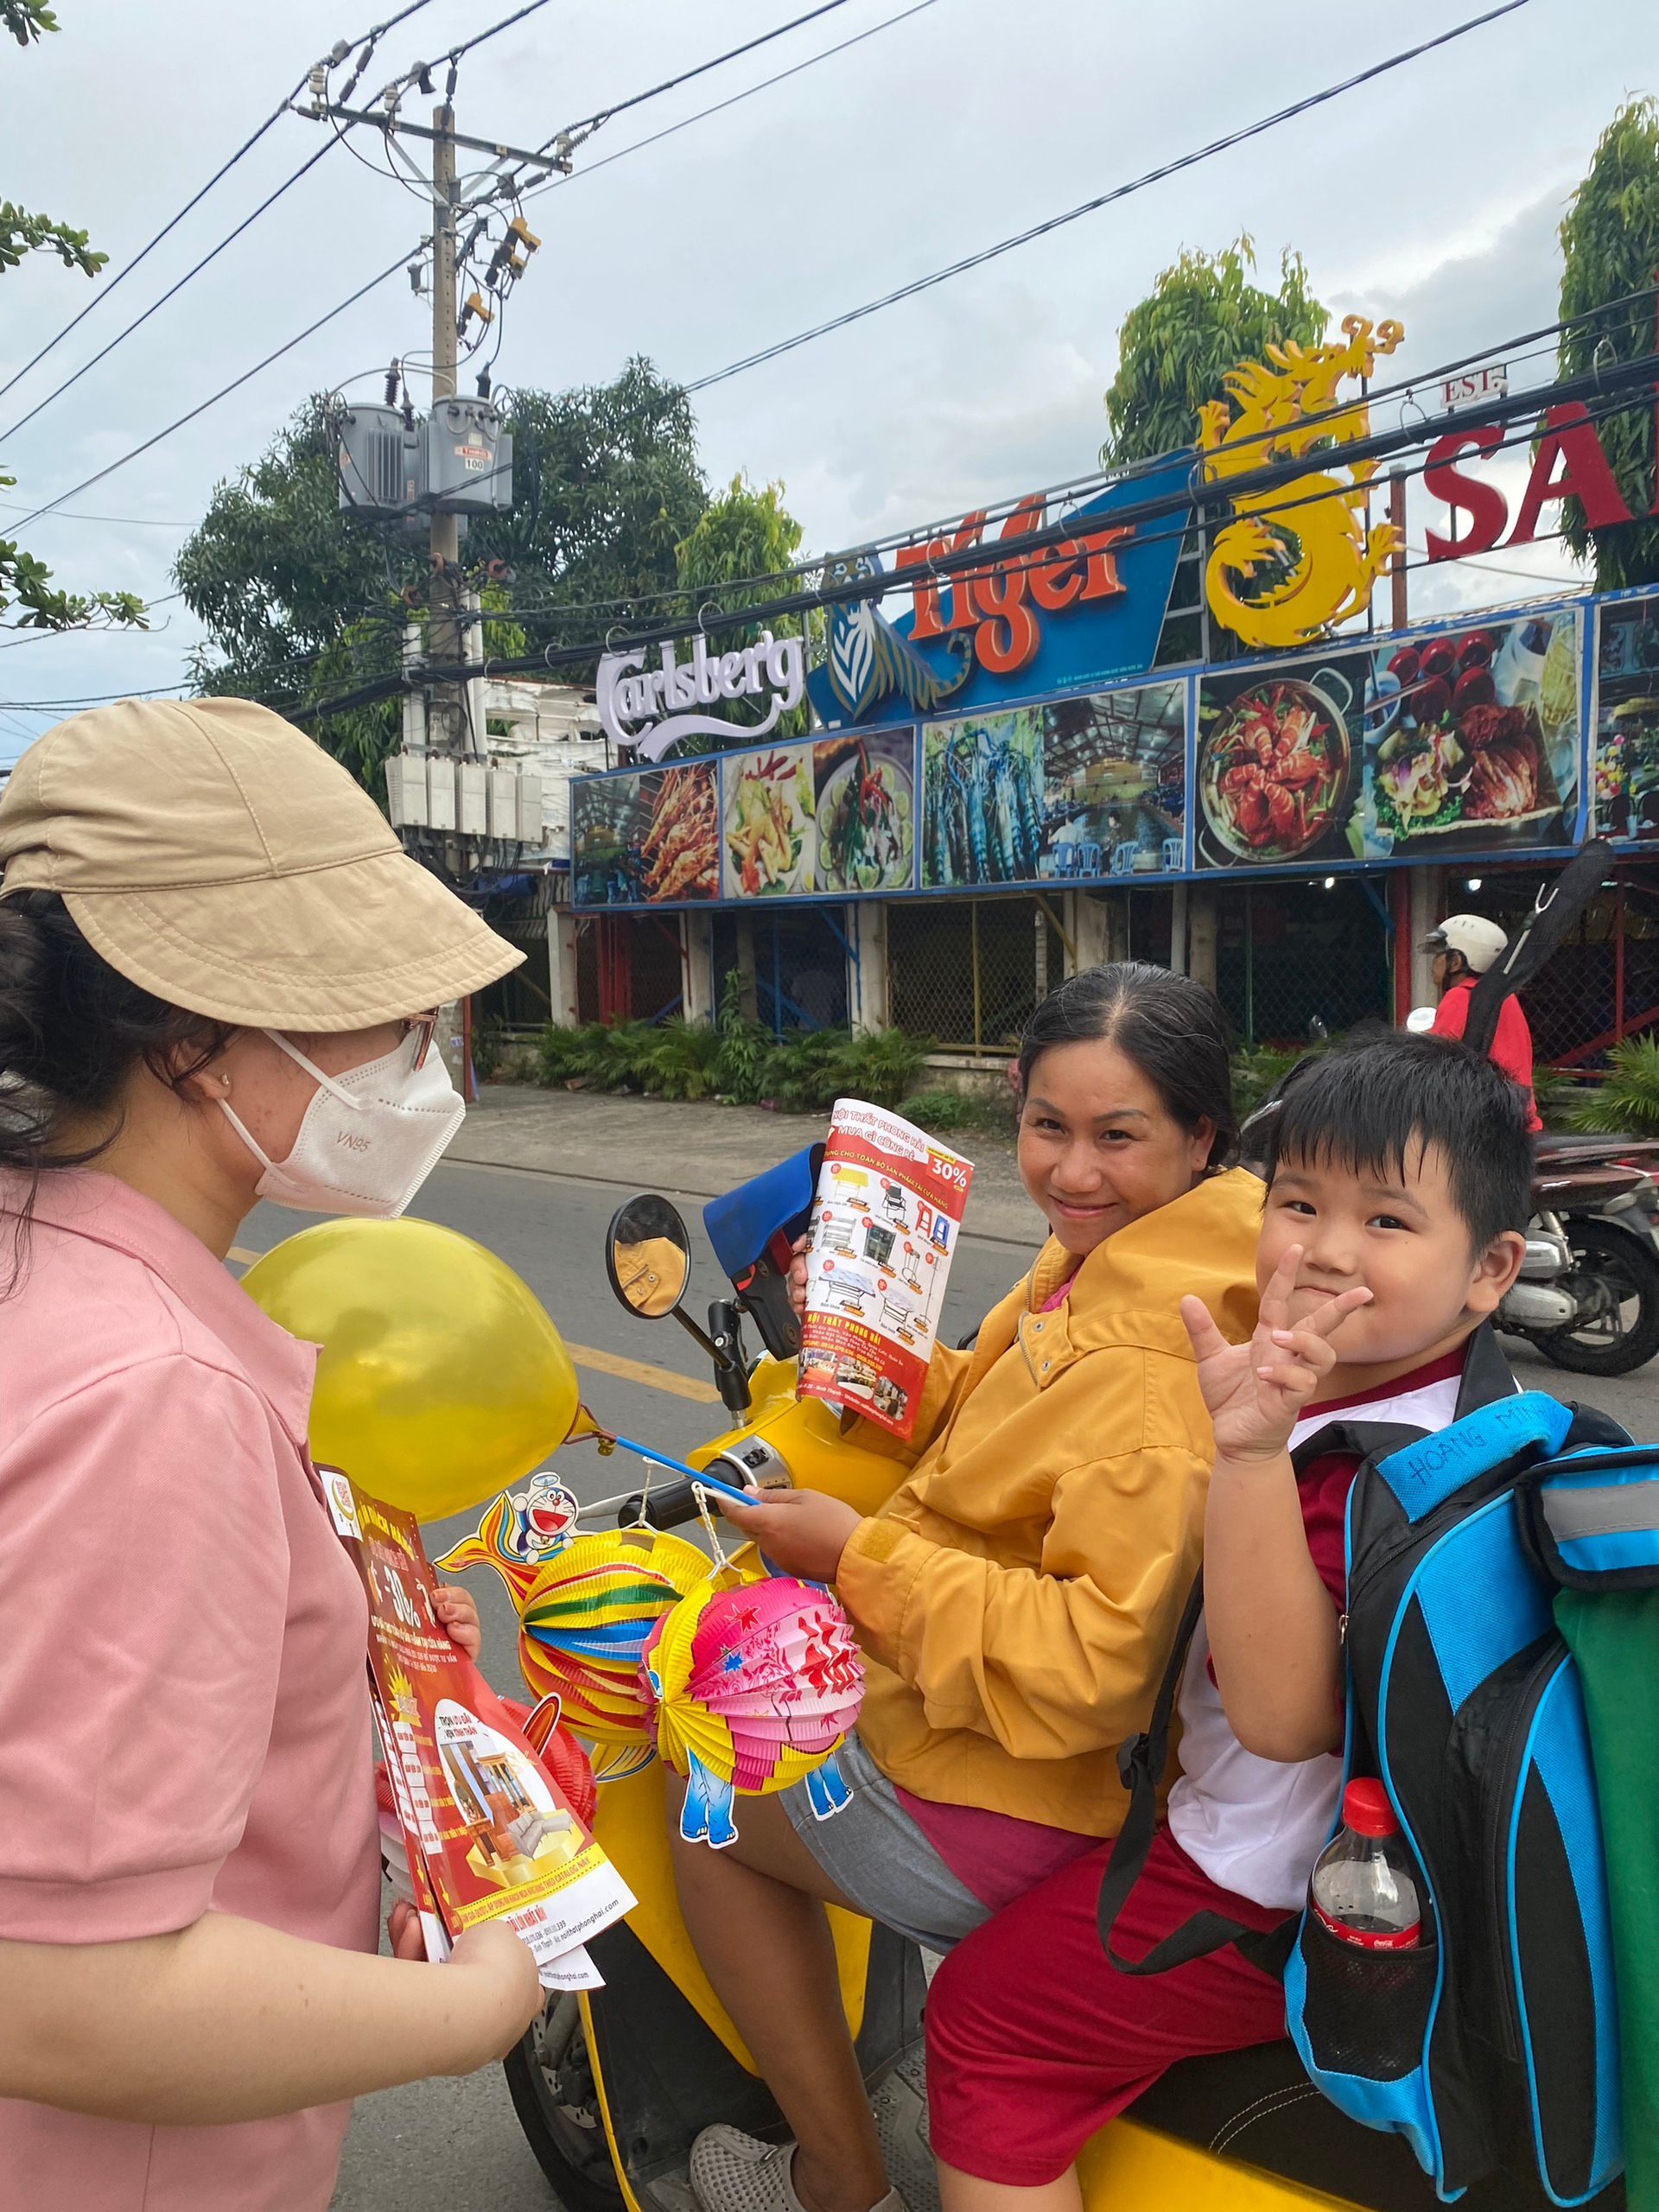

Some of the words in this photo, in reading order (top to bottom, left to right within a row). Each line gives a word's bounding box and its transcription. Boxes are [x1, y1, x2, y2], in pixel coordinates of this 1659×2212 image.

[467, 460, 483, 469] 100
[1424, 380, 1659, 563] SA
[896, 494, 1135, 672] Tiger
[596, 631, 804, 753] Carlsberg
[337, 1130, 372, 1153] VN95
[838, 1125, 863, 1138] MUA
[865, 1130, 877, 1142] GÌ
[877, 1135, 904, 1154] CŨNG
[850, 1111, 878, 1126] THẤT
[878, 1121, 910, 1142] PHONG
[910, 1137, 925, 1153] HẢI
[931, 1158, 966, 1187] 30%
[844, 1321, 868, 1338] PHONG
[555, 1866, 579, 1885] CATALOG
[560, 1899, 620, 1940] noithatphonghai.com
